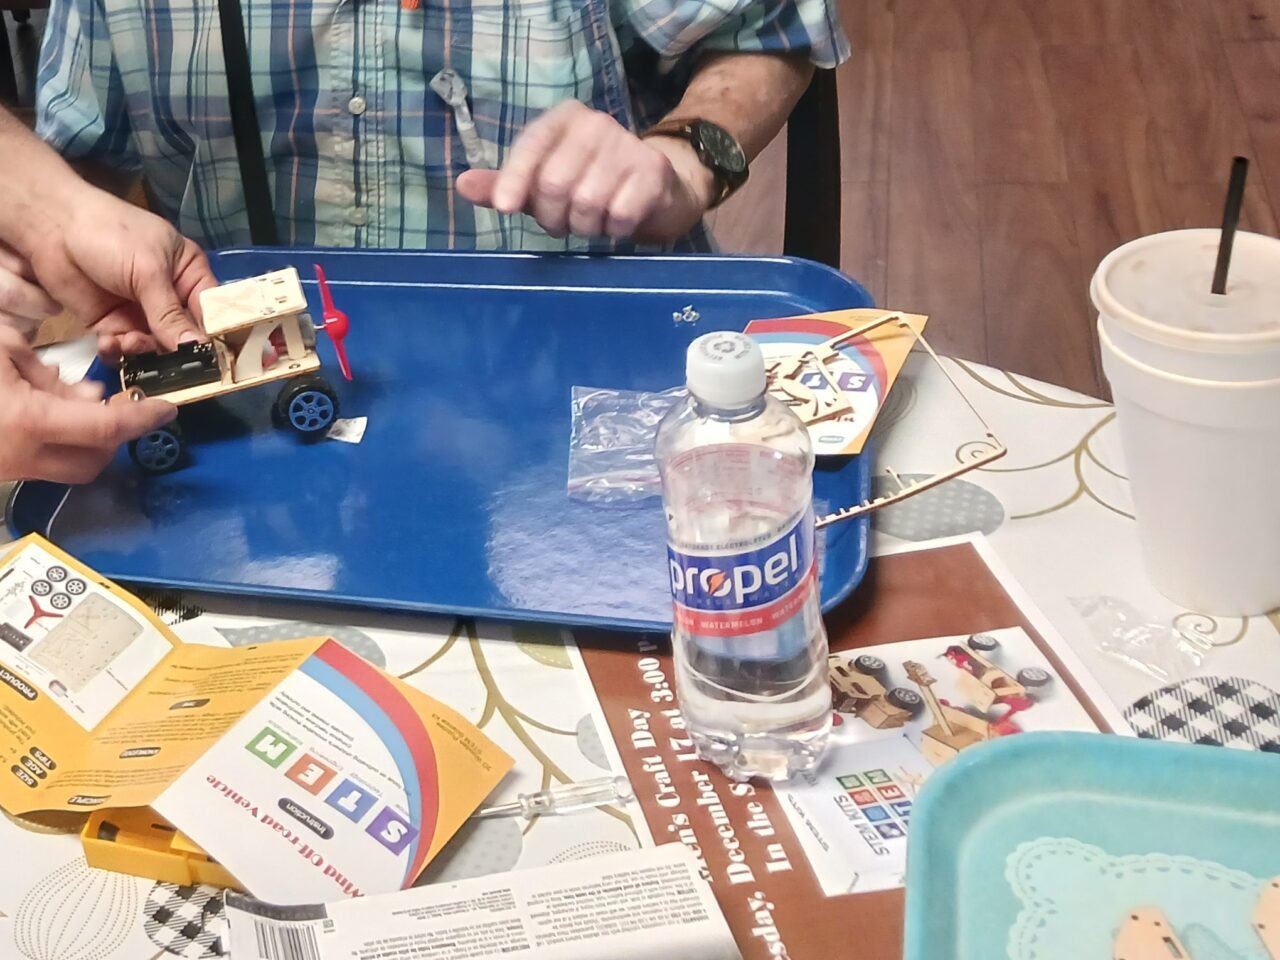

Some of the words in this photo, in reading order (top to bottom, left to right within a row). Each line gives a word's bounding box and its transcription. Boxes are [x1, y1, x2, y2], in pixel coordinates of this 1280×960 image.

[670, 534, 798, 604] propel
[637, 657, 674, 703] 3:00
[628, 708, 659, 751] Day
[24, 758, 44, 775] AGE
[33, 749, 53, 766] TIPS
[14, 768, 35, 785] SIZE
[643, 753, 681, 808] Craft
[206, 774, 259, 818] Vehicle
[833, 794, 863, 821] KITS
[284, 801, 327, 833] Instruction
[380, 820, 408, 843] S
[690, 770, 756, 885] December
[744, 801, 776, 837] the
[671, 813, 714, 882] en's
[854, 822, 890, 856] STEM
[765, 843, 793, 873] In
